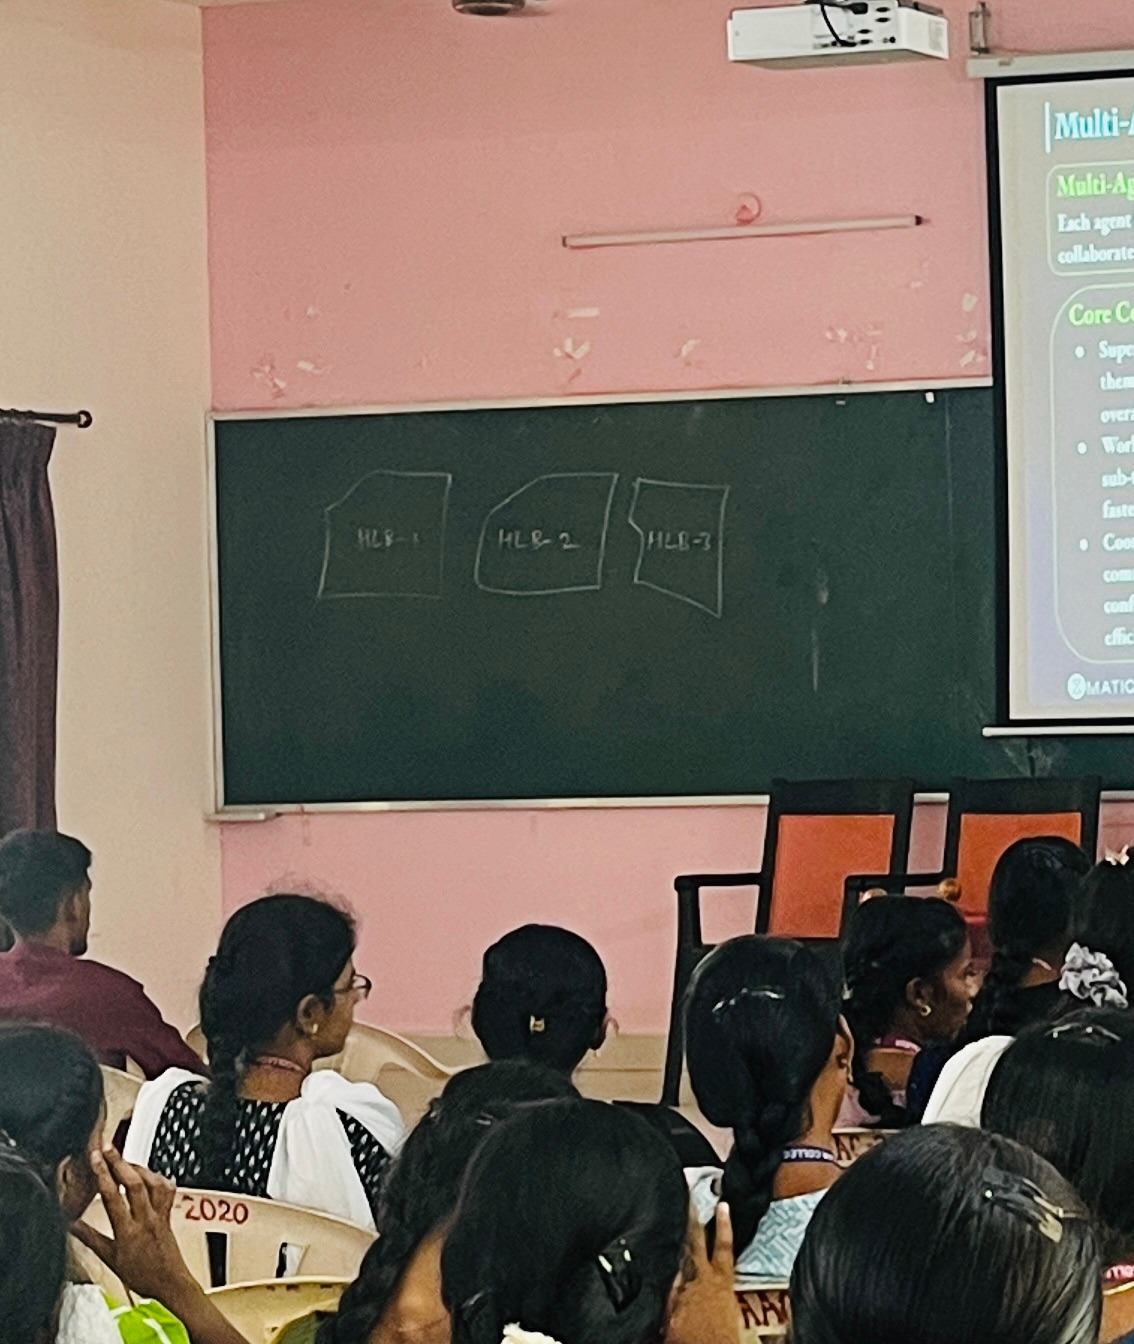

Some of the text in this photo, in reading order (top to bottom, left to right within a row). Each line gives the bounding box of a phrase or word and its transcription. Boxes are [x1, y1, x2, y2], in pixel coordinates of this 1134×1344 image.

[1057, 212, 1090, 233] Each
[1094, 214, 1131, 236] agent
[1057, 242, 1134, 264] collaborate
[1068, 303, 1112, 326] Core
